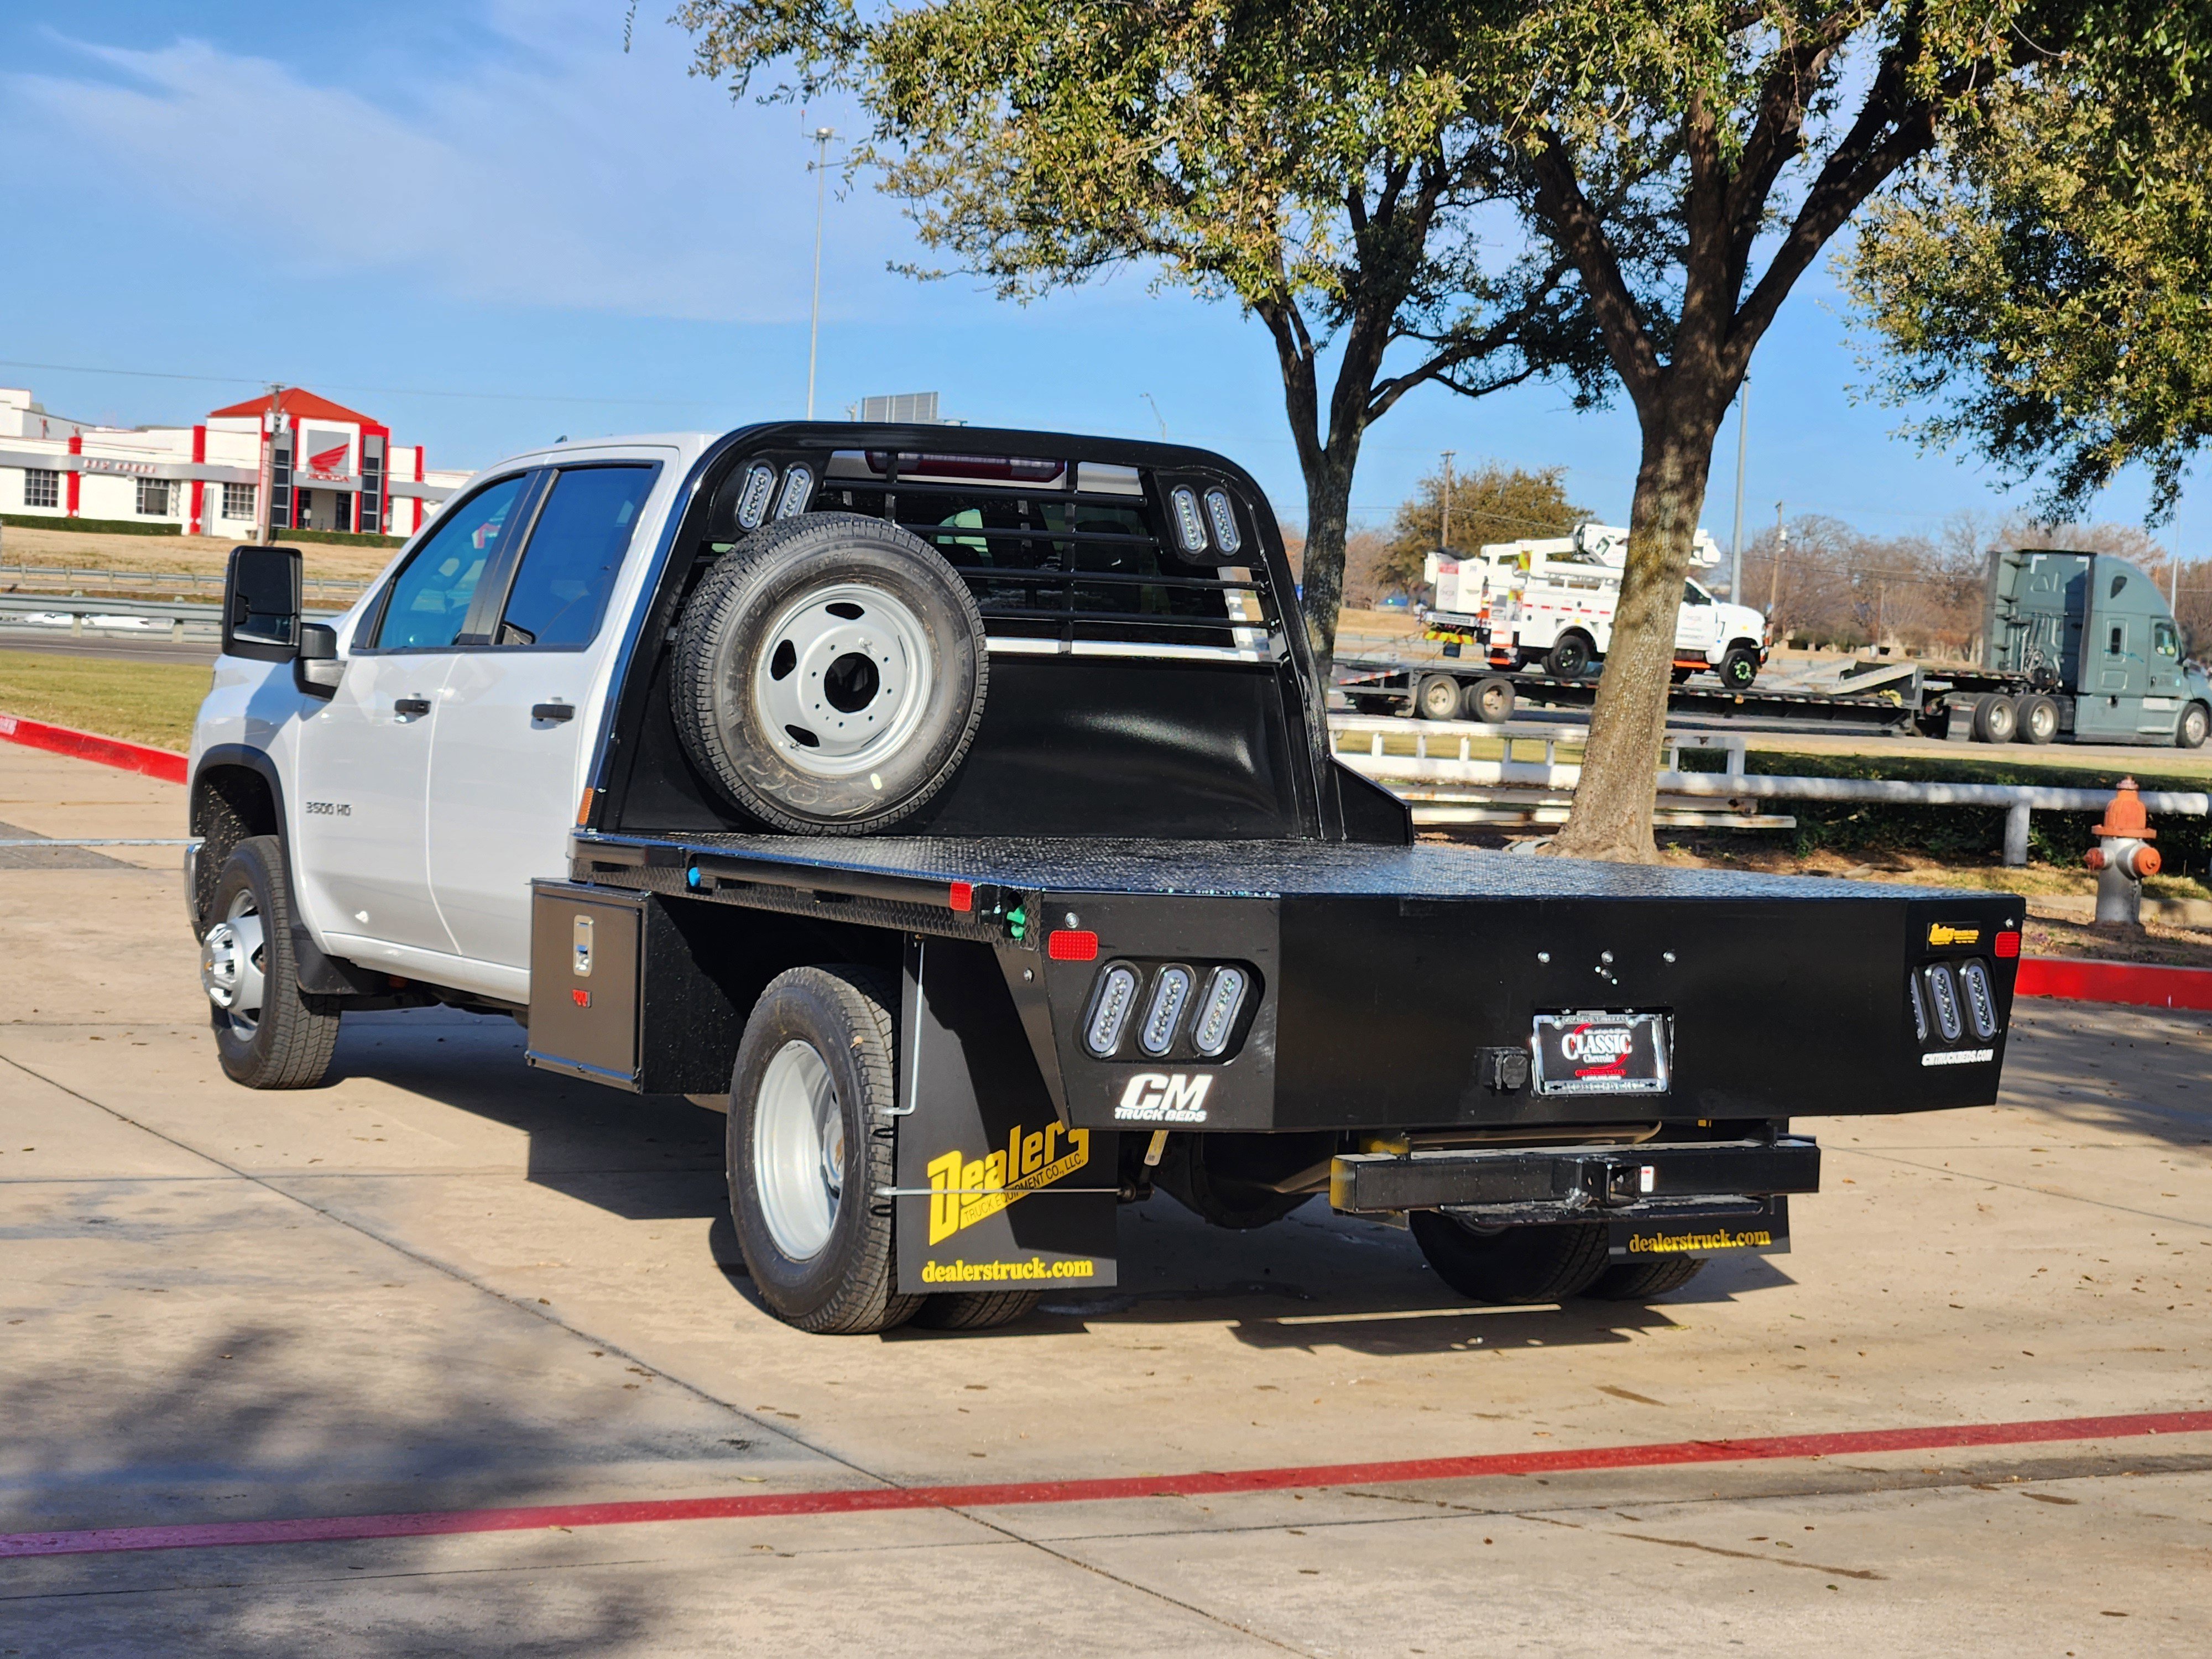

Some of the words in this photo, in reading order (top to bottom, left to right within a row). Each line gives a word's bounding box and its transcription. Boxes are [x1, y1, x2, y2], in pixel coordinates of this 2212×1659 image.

[306, 473, 351, 483] HONDA
[306, 802, 334, 815] 3500
[337, 804, 351, 816] HD
[1562, 1033, 1632, 1060] CLASSIC
[1120, 1073, 1213, 1111] CM
[1114, 1107, 1164, 1121] TRUCK
[1165, 1109, 1207, 1123] BEDS
[927, 1119, 1089, 1246] Dealers
[964, 1198, 994, 1222] TRUCK
[1045, 1164, 1065, 1180] CO.,
[1629, 1229, 1771, 1253] dealerstruck.com
[922, 1257, 1093, 1282] dealerstruck.com
